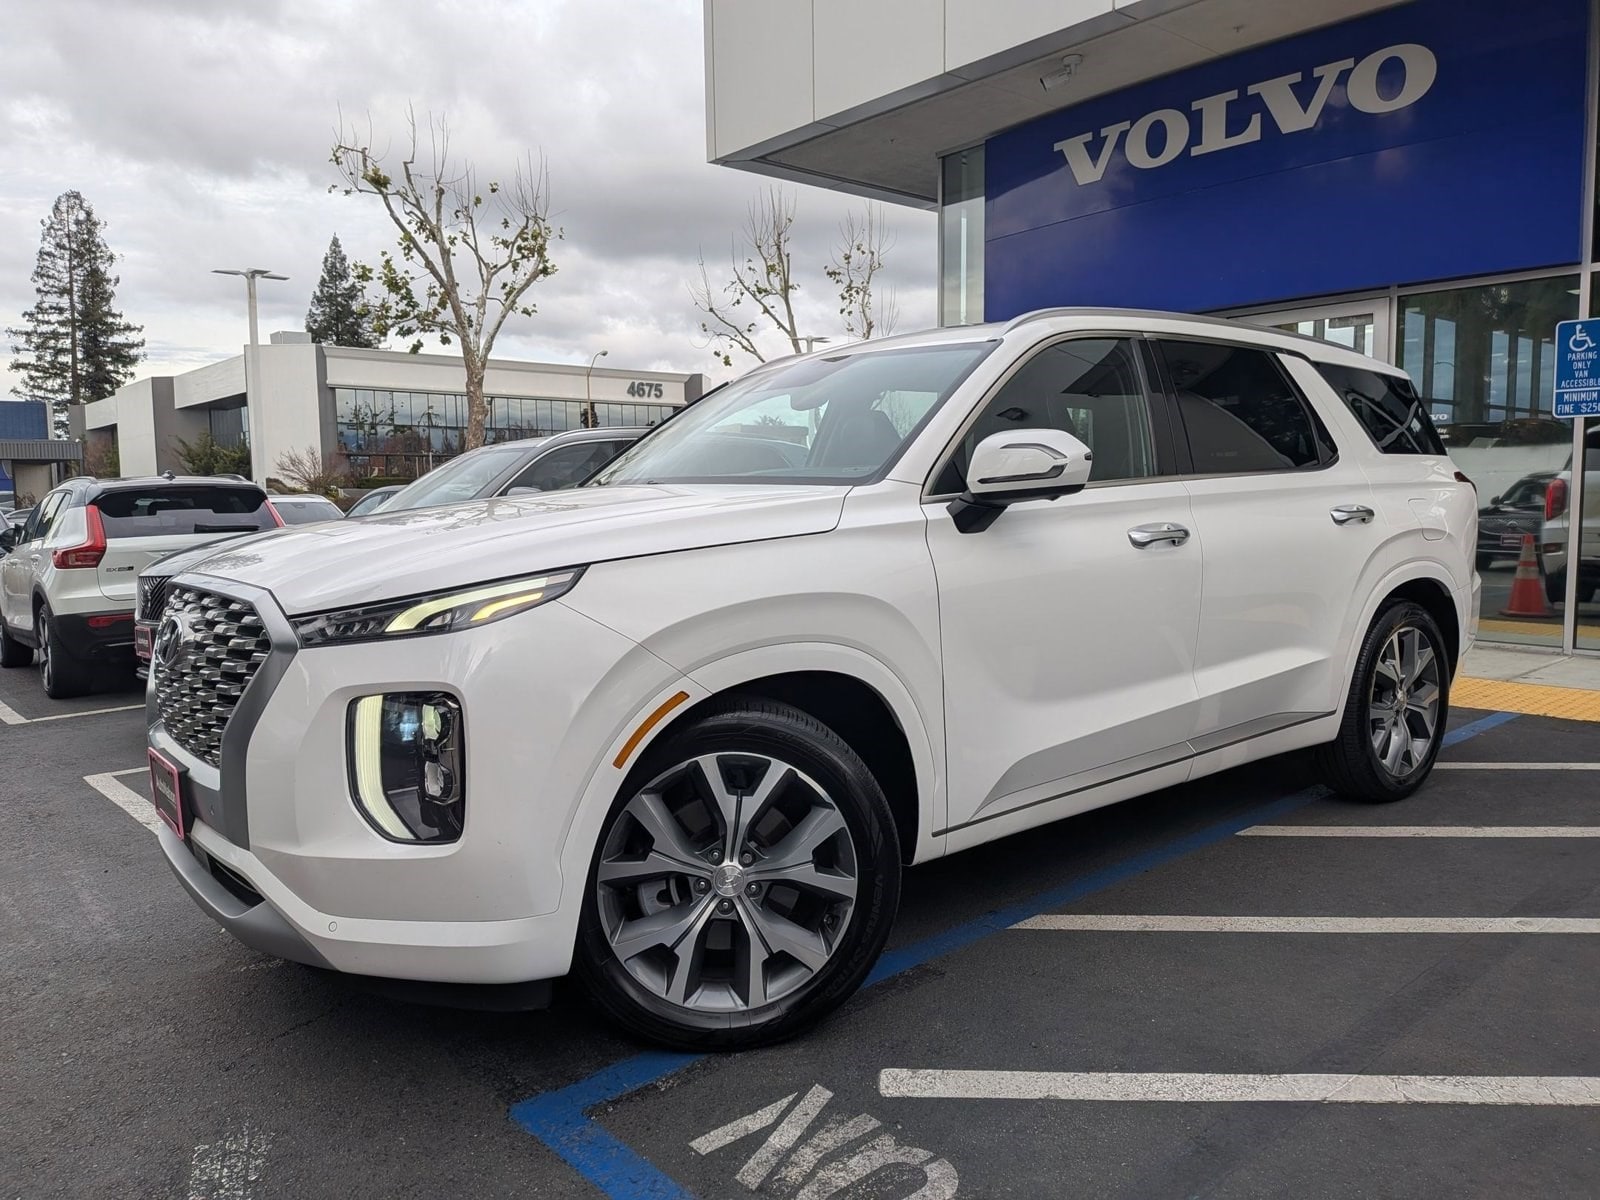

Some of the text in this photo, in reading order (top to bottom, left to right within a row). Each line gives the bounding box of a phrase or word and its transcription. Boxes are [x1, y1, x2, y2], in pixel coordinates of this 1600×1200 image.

[1053, 43, 1438, 186] VOLVO
[1567, 351, 1598, 361] PARKING
[1572, 361, 1592, 370] ONLY
[1574, 370, 1589, 378] VAN
[1561, 378, 1600, 388] ACCESSIBLE
[626, 381, 663, 398] 4675
[1563, 392, 1598, 402] MINIMUM
[1557, 404, 1575, 414] FINE
